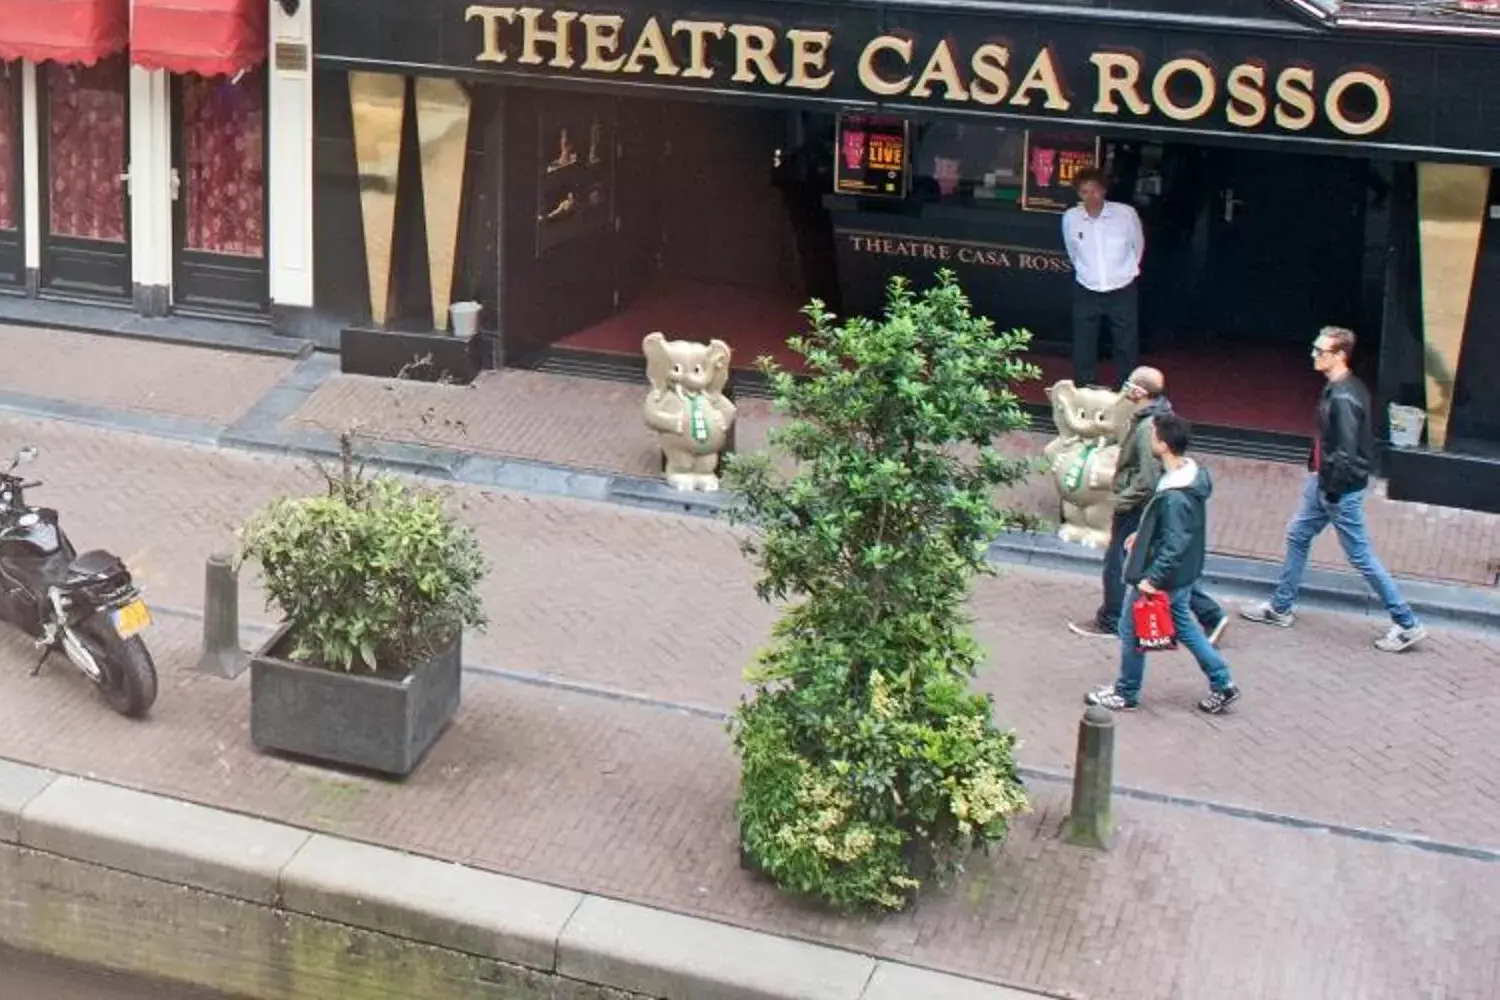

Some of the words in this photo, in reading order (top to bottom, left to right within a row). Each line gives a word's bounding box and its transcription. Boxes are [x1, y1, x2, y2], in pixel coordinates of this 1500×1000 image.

[465, 4, 835, 89] THEATRE
[857, 35, 1071, 112] CASA
[1089, 51, 1393, 136] ROSSO
[851, 236, 950, 261] THEATRE
[958, 248, 1011, 267] CASA
[1018, 253, 1072, 273] ROSS
